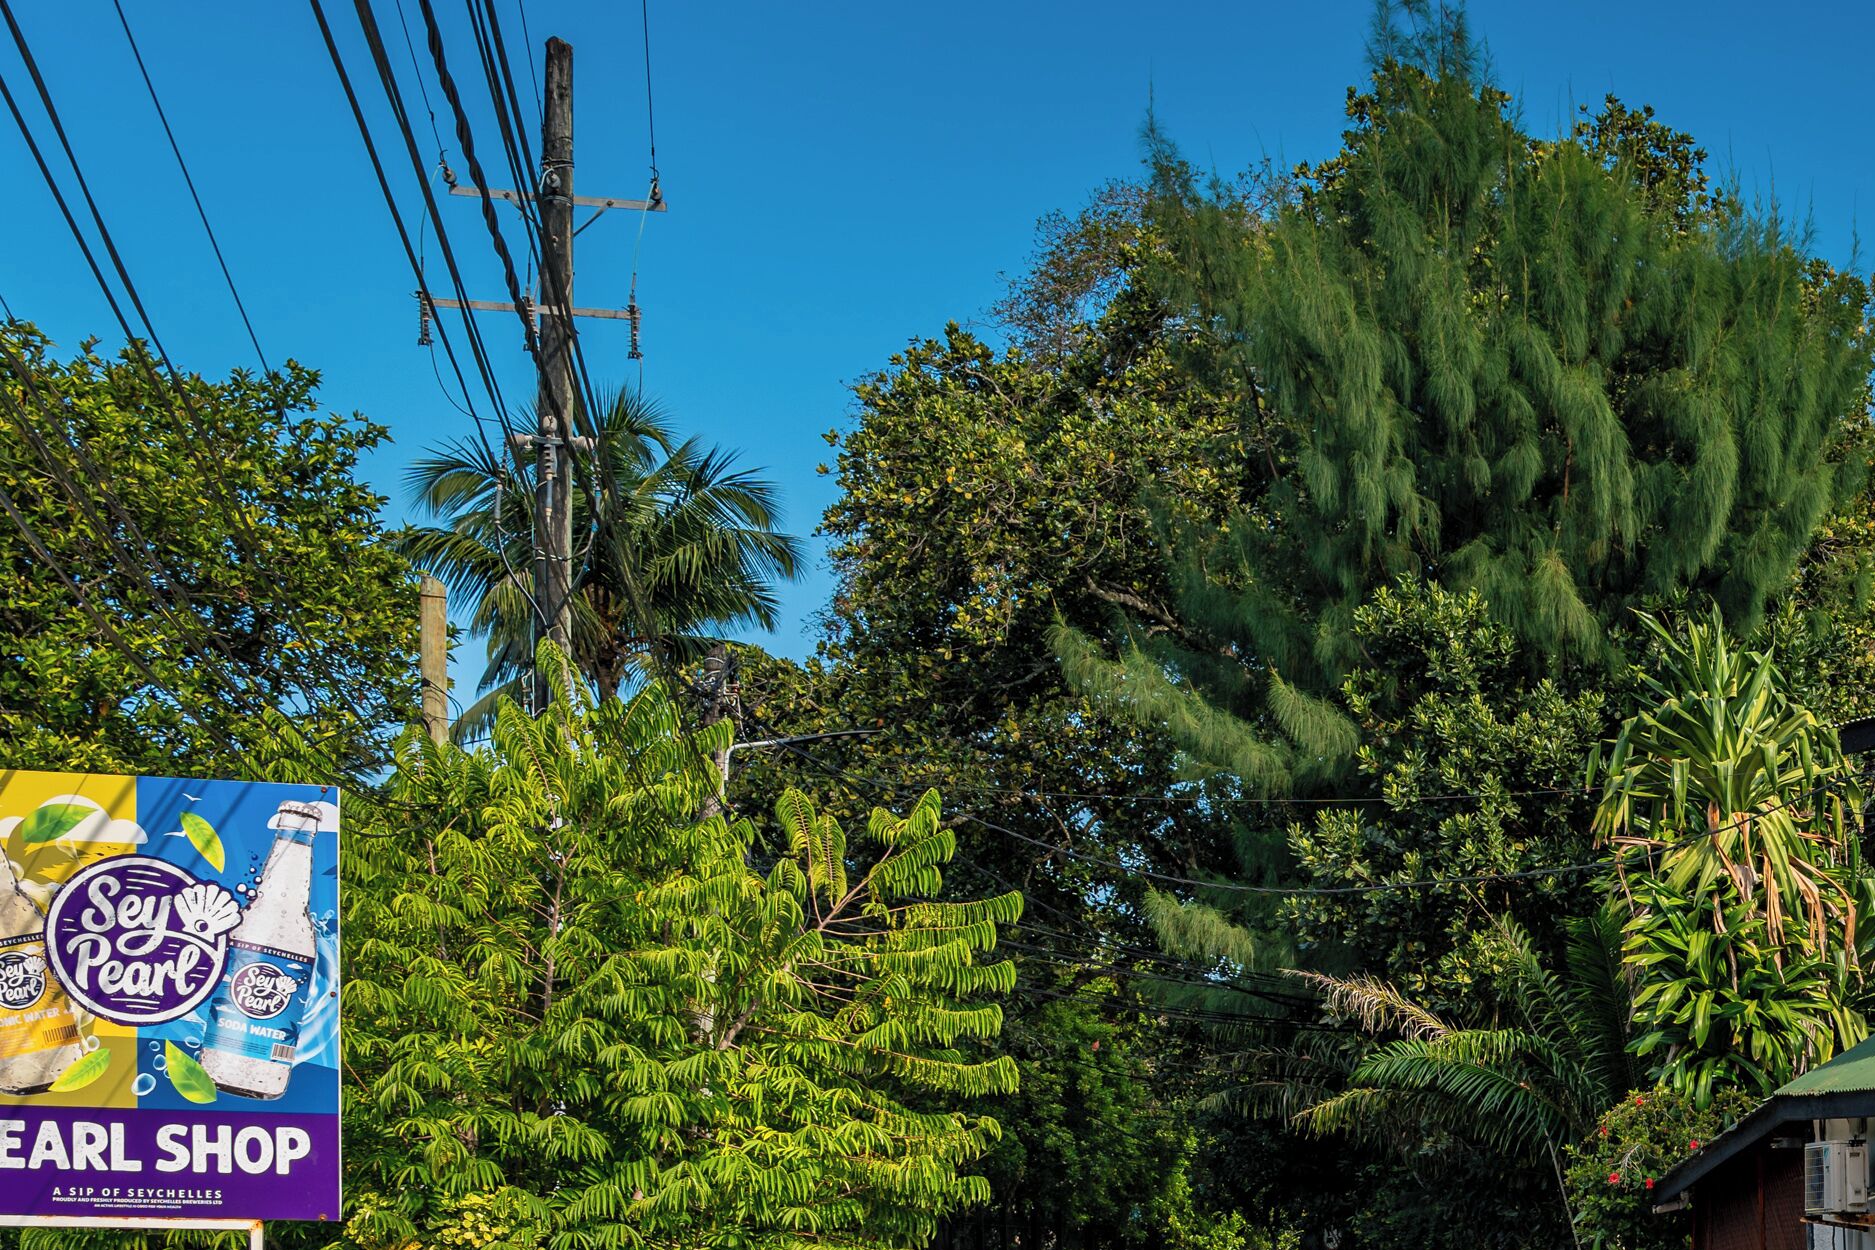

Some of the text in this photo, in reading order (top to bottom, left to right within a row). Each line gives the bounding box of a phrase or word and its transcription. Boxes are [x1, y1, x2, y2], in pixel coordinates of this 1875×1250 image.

[81, 875, 173, 957] Sey
[66, 933, 201, 997] Pearl
[251, 944, 262, 952] OF
[263, 947, 308, 963] SEYCHELLES
[243, 966, 276, 997] Sey
[236, 985, 282, 1012] Pearl
[217, 1017, 287, 1041] SODA WATER
[155, 1123, 311, 1175] SHOP
[52, 1187, 222, 1199] A SIP OF SEYCHELLES
